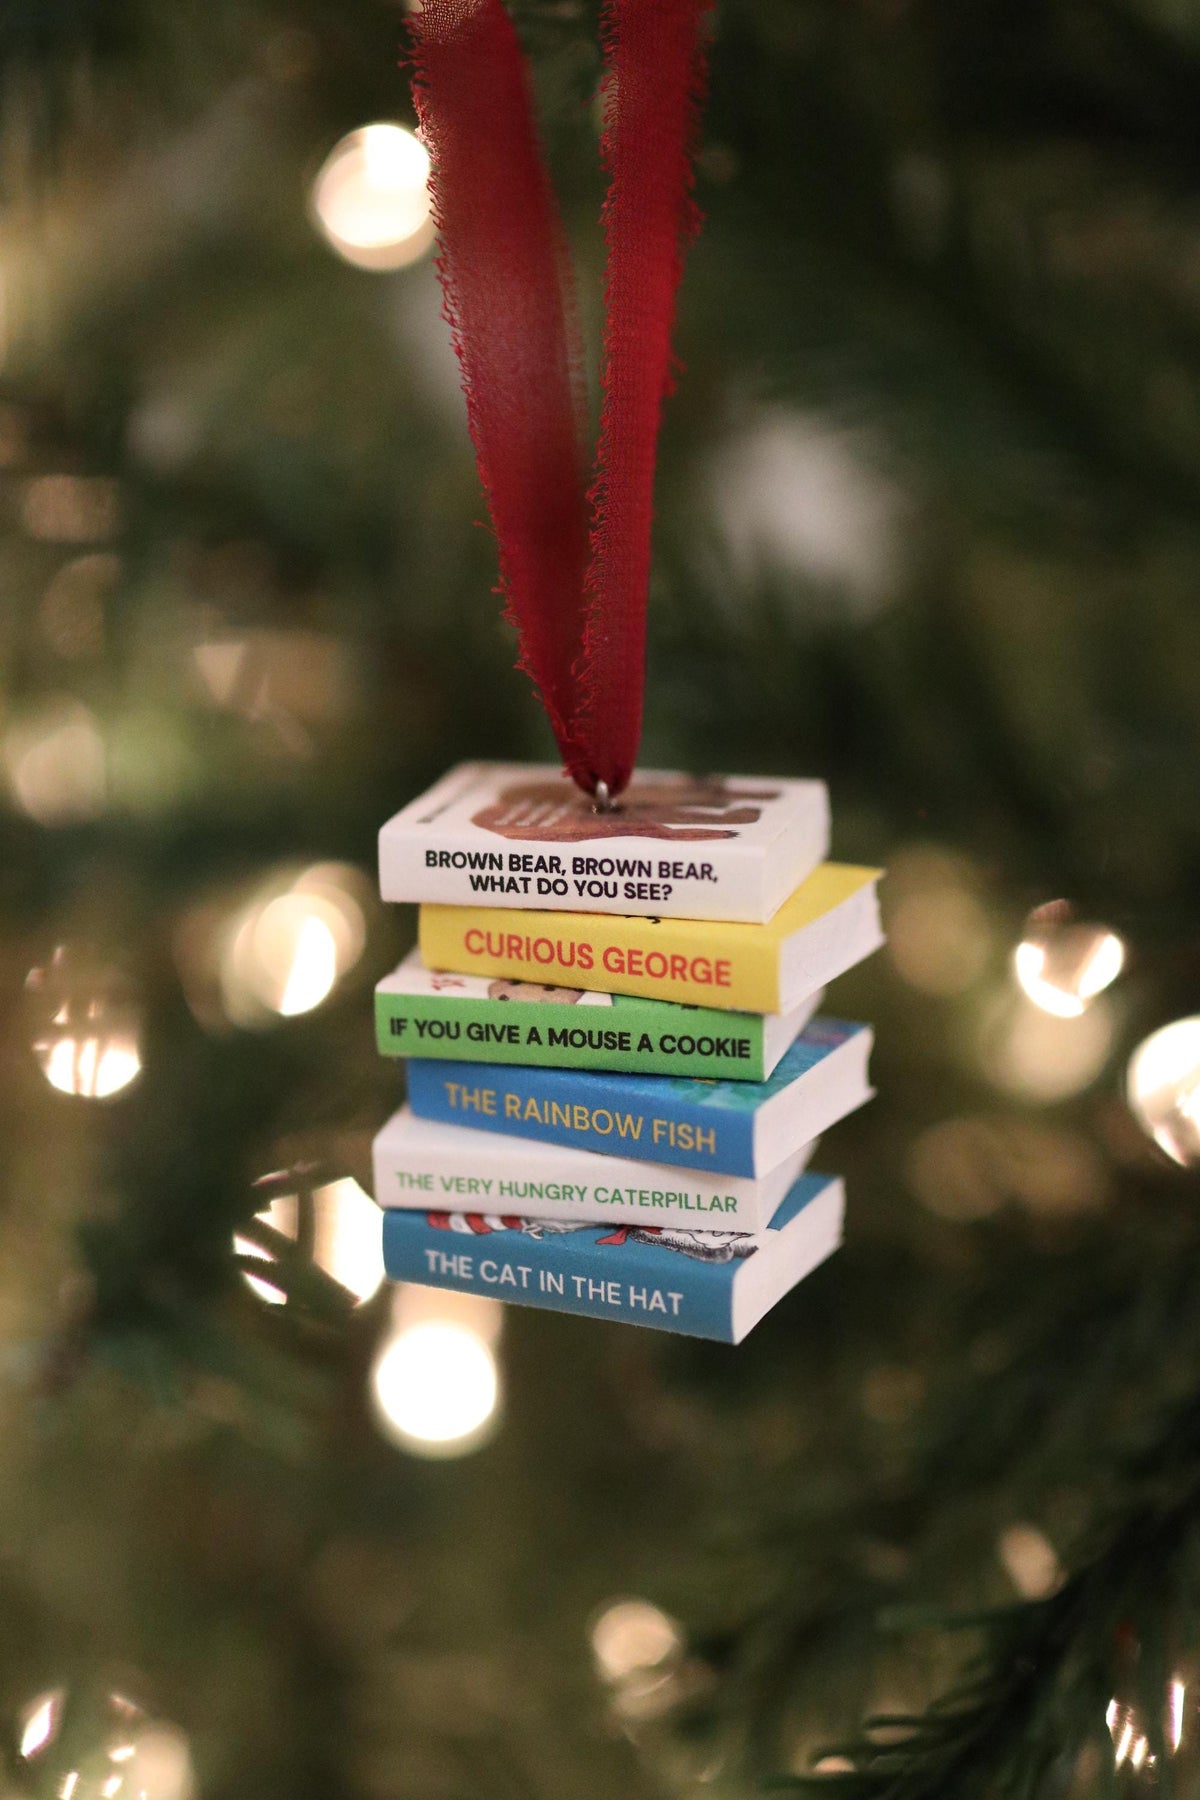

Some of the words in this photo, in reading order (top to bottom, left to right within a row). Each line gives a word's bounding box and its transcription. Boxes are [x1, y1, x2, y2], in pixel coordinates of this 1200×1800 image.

[426, 850, 502, 870] BROWN
[509, 854, 566, 876] BEAR,
[572, 857, 652, 878] BROWN
[658, 861, 718, 883] BEAR,
[469, 874, 531, 894] WHAT
[537, 877, 568, 896] DO
[574, 879, 618, 898] YOU
[623, 881, 673, 900] SEE?
[464, 928, 594, 970] CURIOUS
[602, 946, 731, 987] GEORGE
[390, 1017, 408, 1036] IF
[414, 1018, 461, 1040] YOU
[466, 1022, 520, 1044] GIVE
[526, 1026, 543, 1045] A
[548, 1027, 631, 1051] MOUSE
[637, 1033, 653, 1052] A
[659, 1034, 751, 1058] COOKIE
[444, 1082, 497, 1115] THE
[505, 1093, 643, 1140] RAINBOW
[652, 1118, 716, 1154] FISH
[396, 1171, 434, 1190] THE
[440, 1176, 493, 1195] VERY
[499, 1180, 587, 1201] HUNGRY
[594, 1187, 738, 1213] CATERPILLAR
[424, 1250, 474, 1280] THE
[480, 1260, 533, 1289] CAT
[539, 1270, 564, 1295] IN
[571, 1275, 622, 1305] THE
[630, 1285, 684, 1315] HAT
